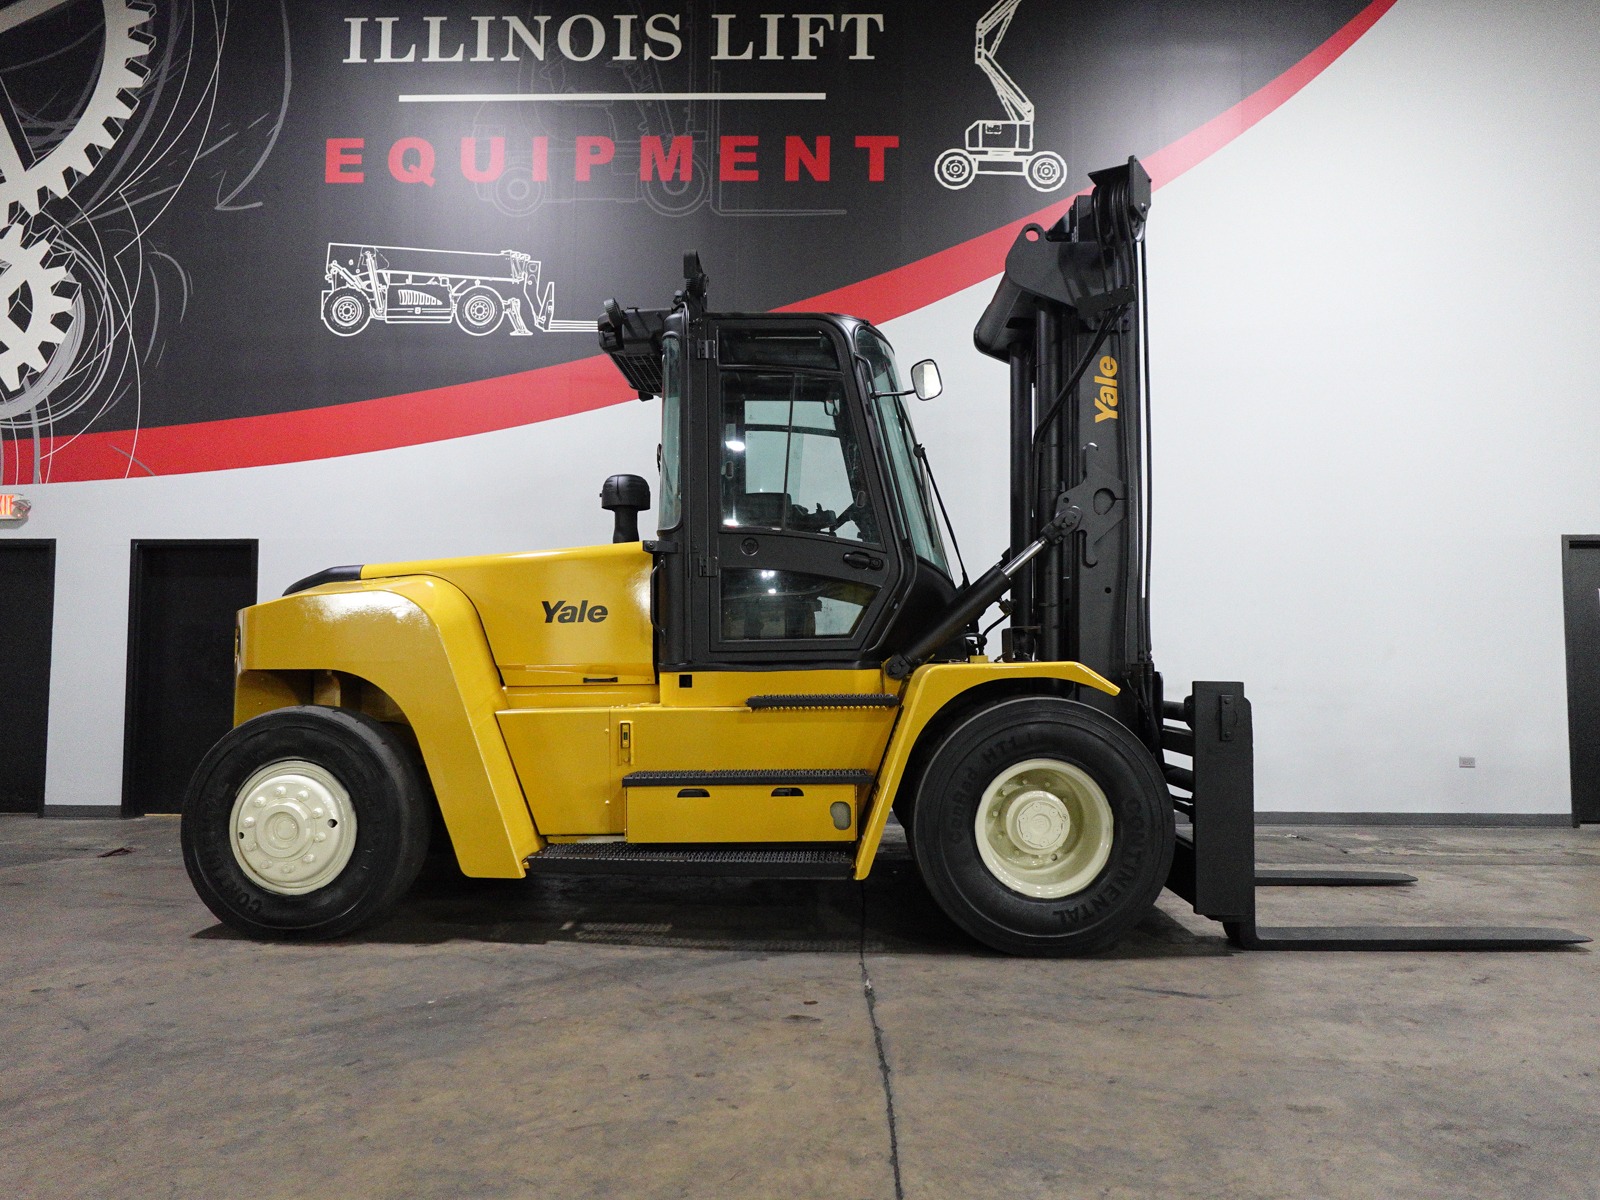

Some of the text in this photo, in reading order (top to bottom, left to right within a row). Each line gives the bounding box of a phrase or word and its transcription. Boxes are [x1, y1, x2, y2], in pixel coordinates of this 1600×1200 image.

[342, 12, 886, 64] ILLINOIS LIFT
[324, 135, 901, 187] EQUIPMENT
[1093, 355, 1119, 424] Yale
[541, 600, 609, 624] Yale
[1051, 796, 1147, 926] CONTINENTAL
